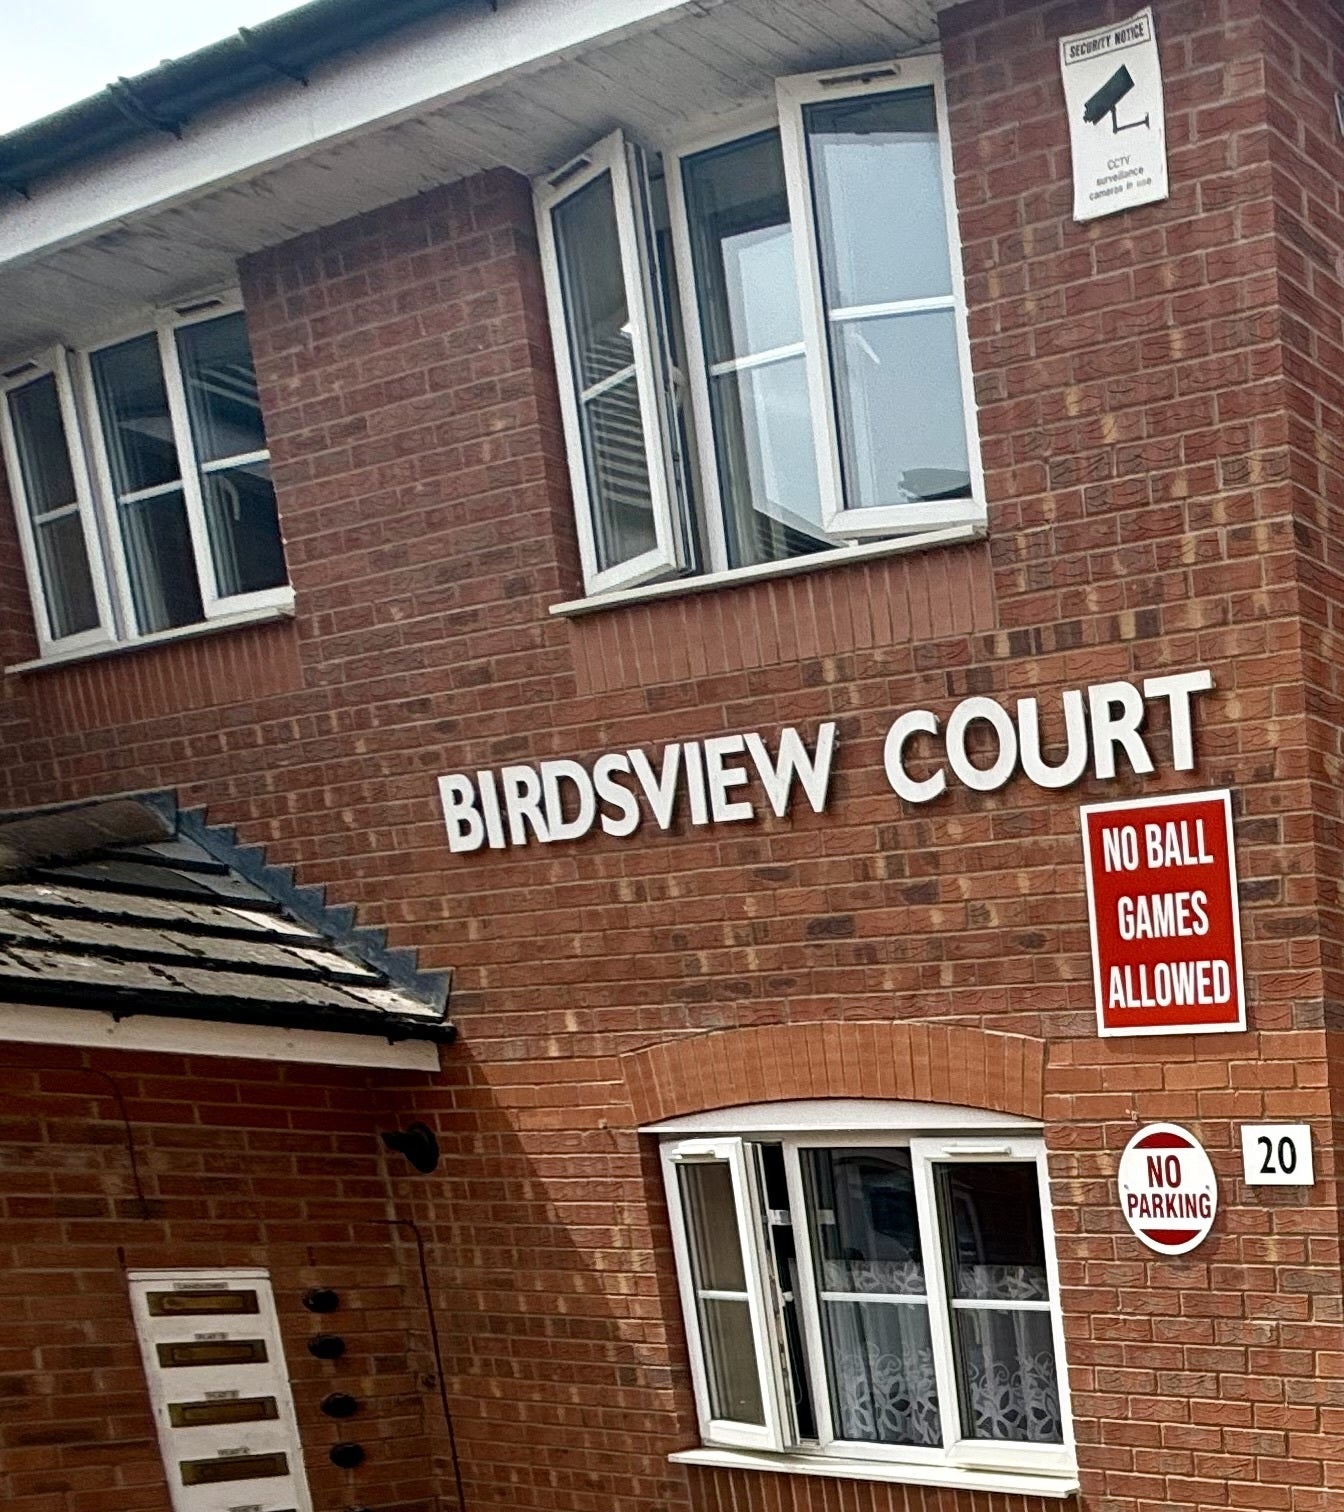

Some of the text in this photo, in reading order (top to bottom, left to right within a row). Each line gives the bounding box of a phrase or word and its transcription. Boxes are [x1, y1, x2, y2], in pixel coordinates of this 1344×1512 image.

[1070, 21, 1145, 59] SECURITY NOTICE
[1107, 155, 1130, 170] CCTV
[437, 669, 1213, 853] BIRDSVIEW COURT
[1102, 818, 1214, 873] NO BALL
[1117, 890, 1210, 941] GAMES
[1108, 959, 1231, 1009] ALLOWED
[1146, 1154, 1182, 1189] NO
[1257, 1135, 1298, 1174] 20
[1126, 1193, 1212, 1219] PARKING
